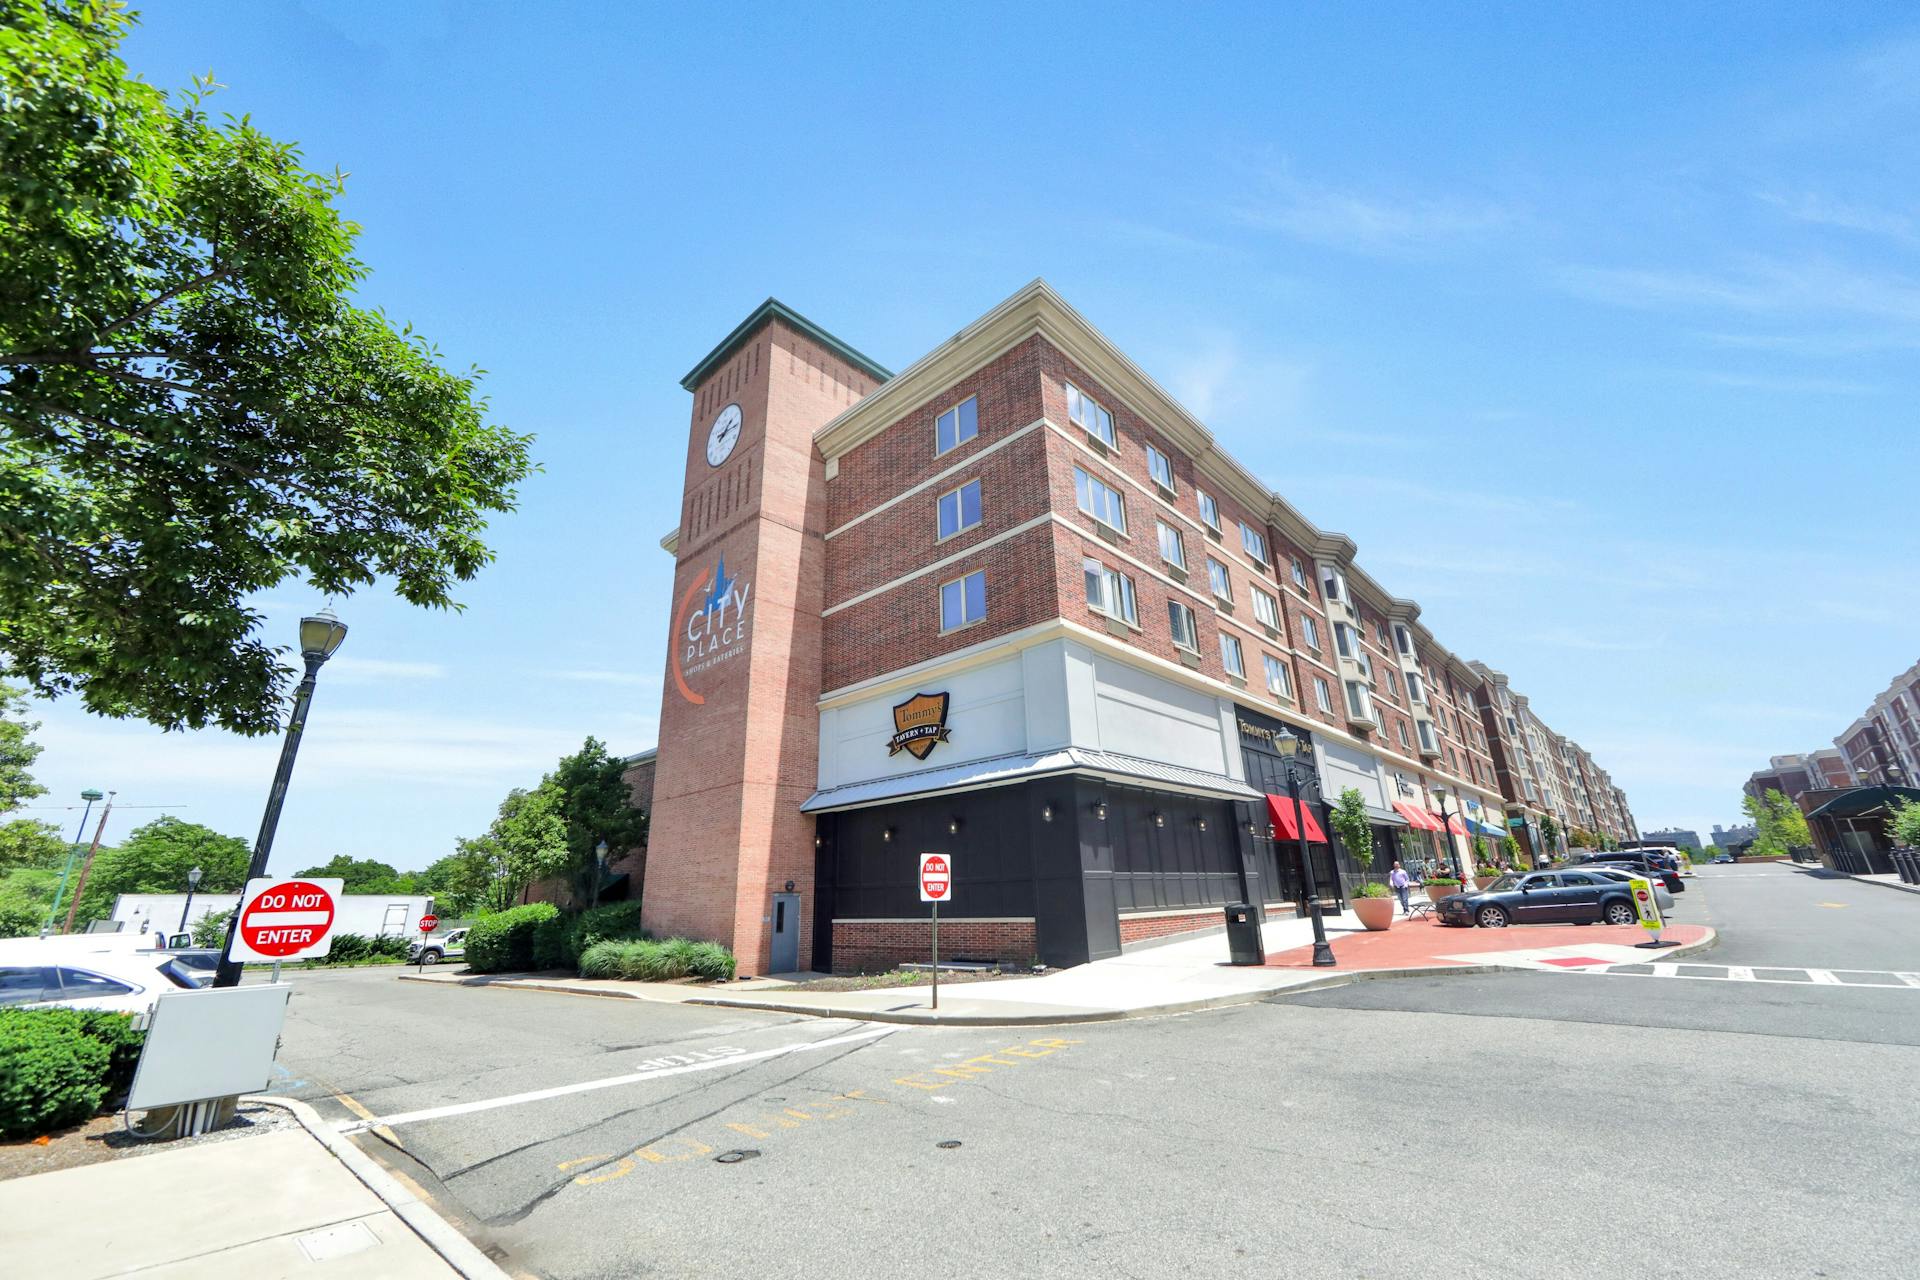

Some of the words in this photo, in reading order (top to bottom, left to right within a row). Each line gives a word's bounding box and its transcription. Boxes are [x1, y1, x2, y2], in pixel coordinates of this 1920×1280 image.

[687, 583, 750, 642] CITY
[686, 621, 745, 662] PLACE
[895, 729, 919, 743] TAVERN
[925, 726, 937, 734] TAP
[926, 863, 934, 871] DO
[935, 863, 945, 871] NOT
[927, 883, 944, 891] ENTER
[261, 895, 286, 909] DO
[291, 894, 324, 908] NOT
[420, 919, 438, 928] STOP
[256, 929, 312, 945] ENTER
[894, 1038, 1086, 1090] ENTER
